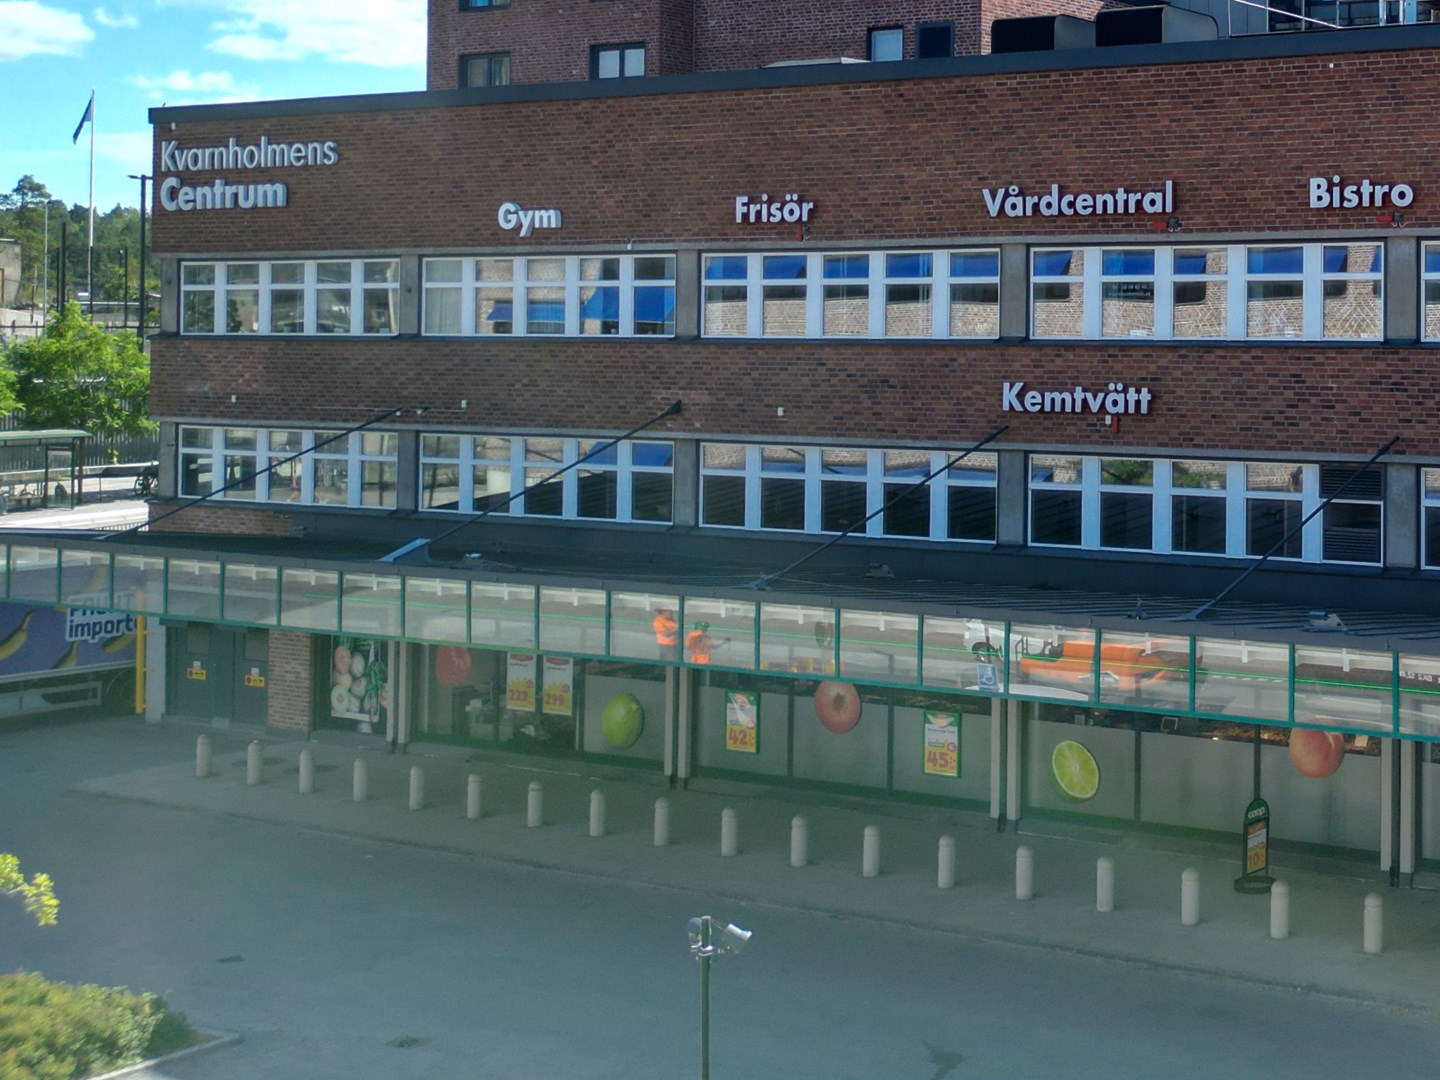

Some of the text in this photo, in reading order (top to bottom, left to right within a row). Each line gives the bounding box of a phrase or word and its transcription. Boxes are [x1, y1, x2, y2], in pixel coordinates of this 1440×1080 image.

[160, 136, 339, 173] Kvarnholmens
[160, 176, 287, 212] Centrum
[735, 193, 815, 224] Frisör
[982, 180, 1174, 218] Vårdcentral
[1309, 175, 1414, 209] Bistro
[498, 202, 562, 237] Gym
[1003, 381, 1152, 415] Kemtvätt
[68, 613, 139, 640] import
